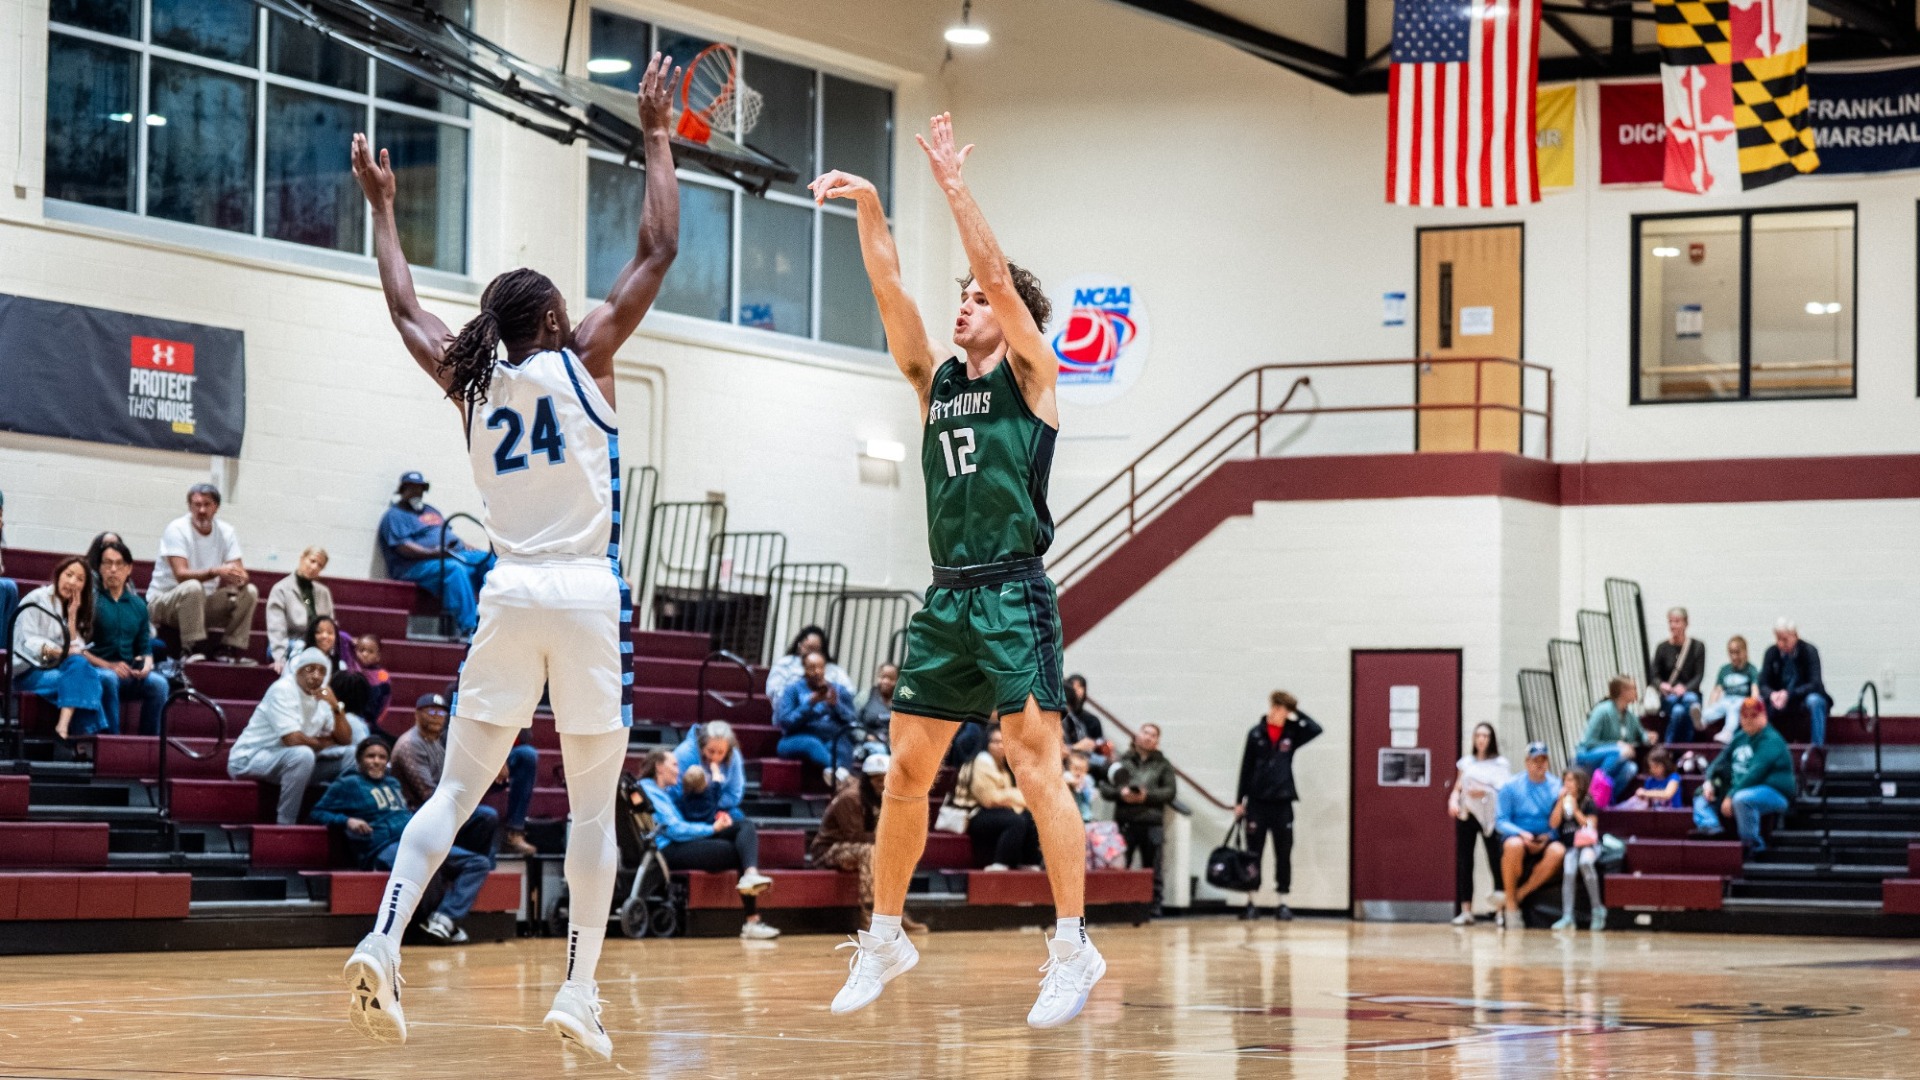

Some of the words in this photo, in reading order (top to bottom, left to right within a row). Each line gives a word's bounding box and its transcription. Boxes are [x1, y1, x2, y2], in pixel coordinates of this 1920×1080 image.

[1073, 286, 1131, 306] NCAA
[129, 367, 195, 402] PROTECT
[127, 396, 155, 420] THIS
[486, 395, 566, 475] 24
[938, 427, 977, 477] 12
